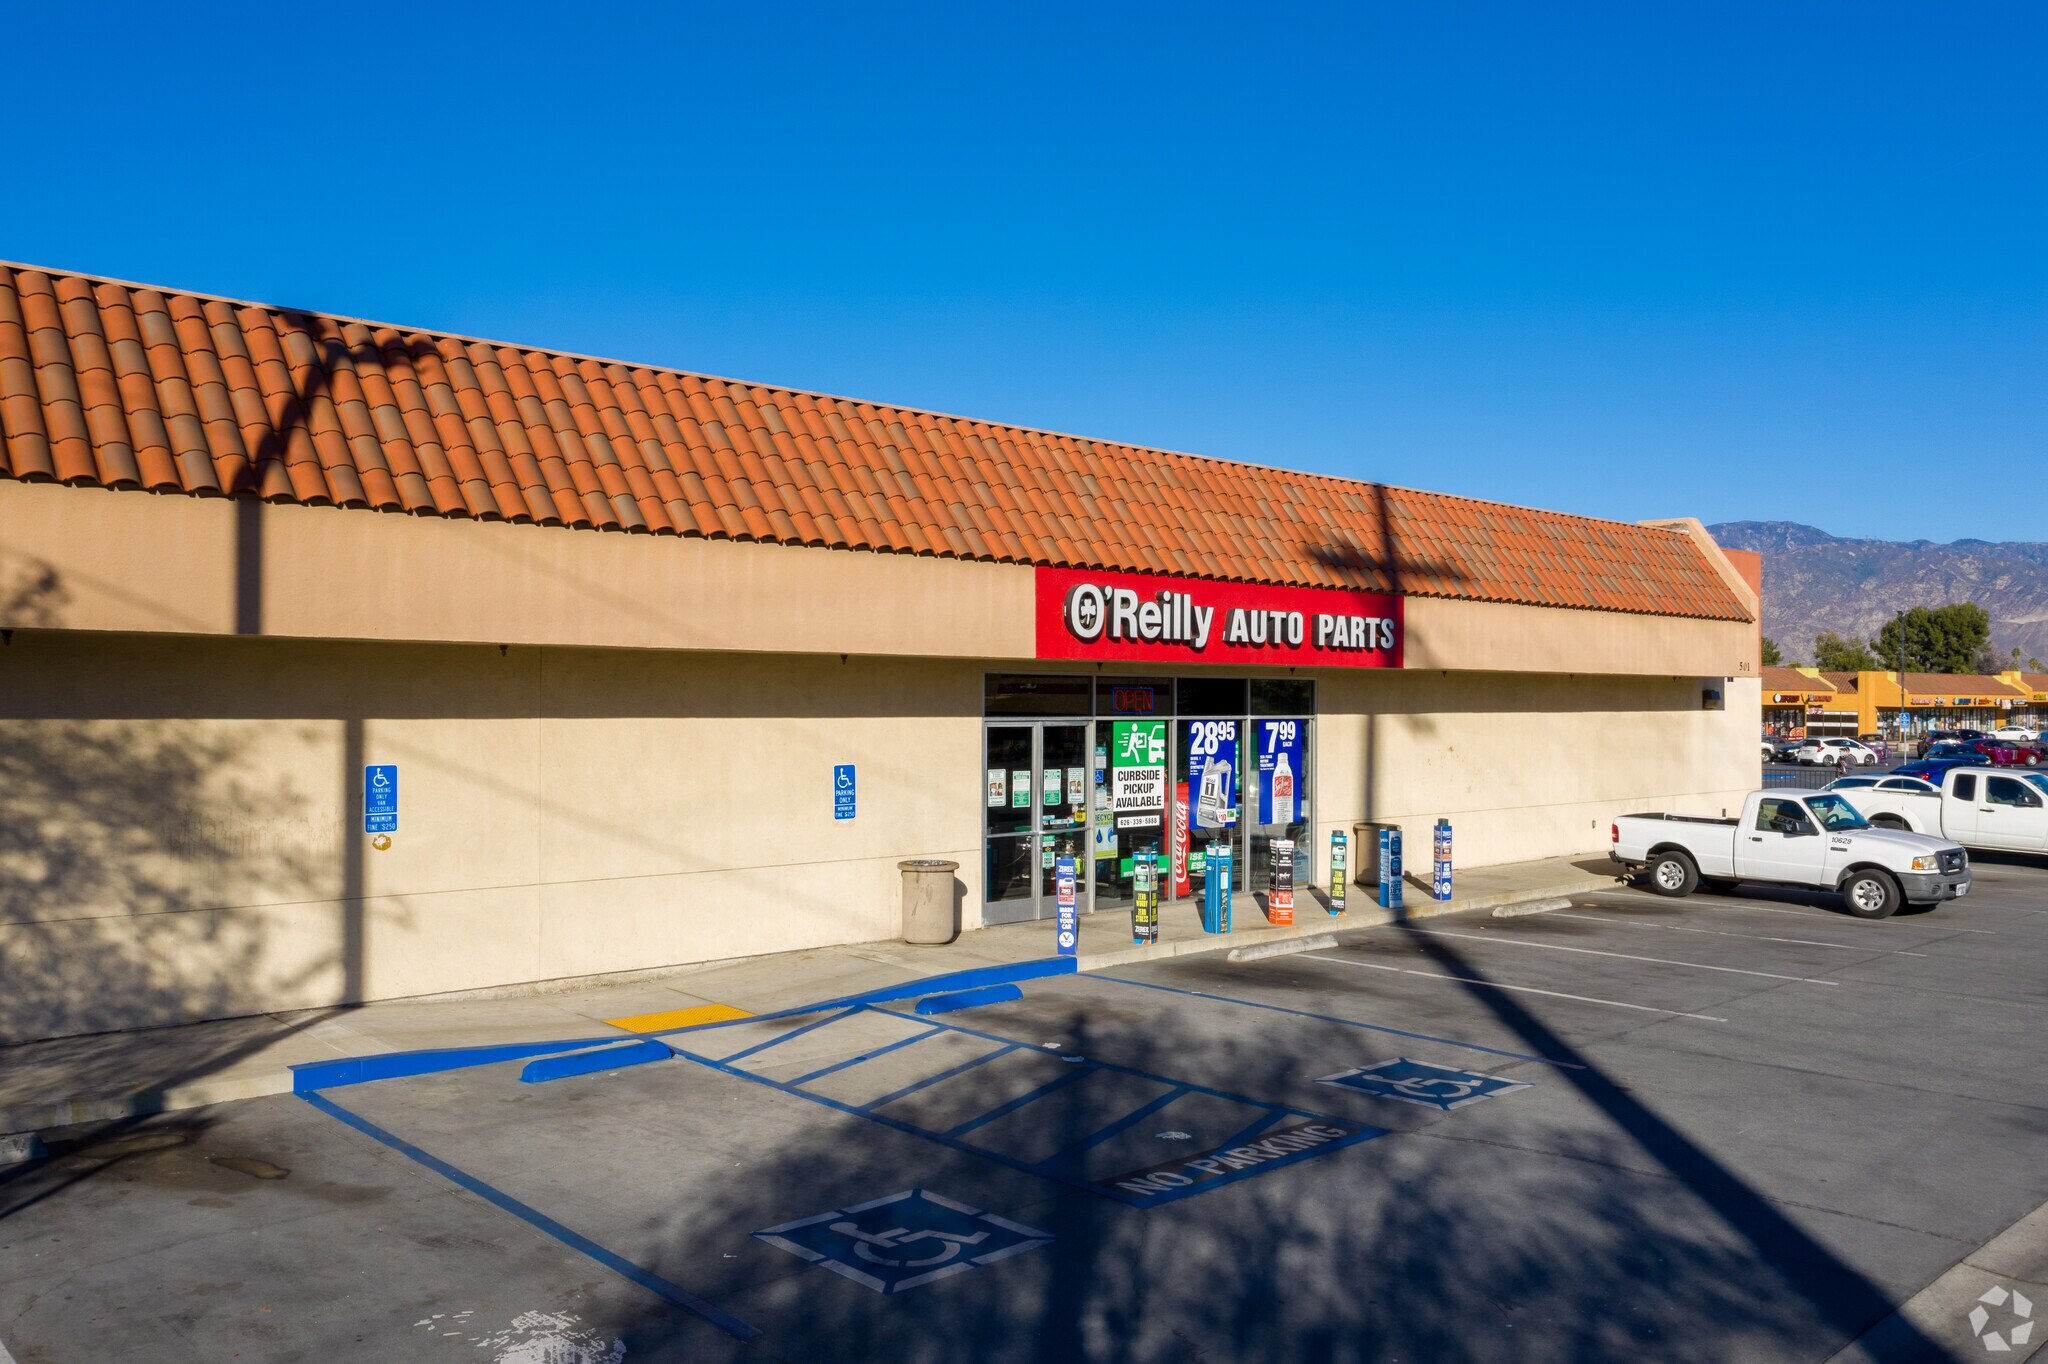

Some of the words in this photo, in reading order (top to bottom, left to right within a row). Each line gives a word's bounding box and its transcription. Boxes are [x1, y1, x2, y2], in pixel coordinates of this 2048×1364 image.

[1071, 583, 1214, 648] O'Reilly
[1228, 608, 1304, 645] AUTO
[1318, 614, 1395, 649] PARTS
[1739, 661, 1750, 671] 501
[1114, 689, 1153, 712] OPEN
[1117, 769, 1160, 782] CURBSIDE
[1123, 783, 1155, 794] PICKUP
[1115, 796, 1162, 808] AVAILABLE
[371, 815, 392, 823] MINIMUM
[1115, 1171, 1194, 1196] NO
[1185, 1125, 1348, 1175] PARKING
